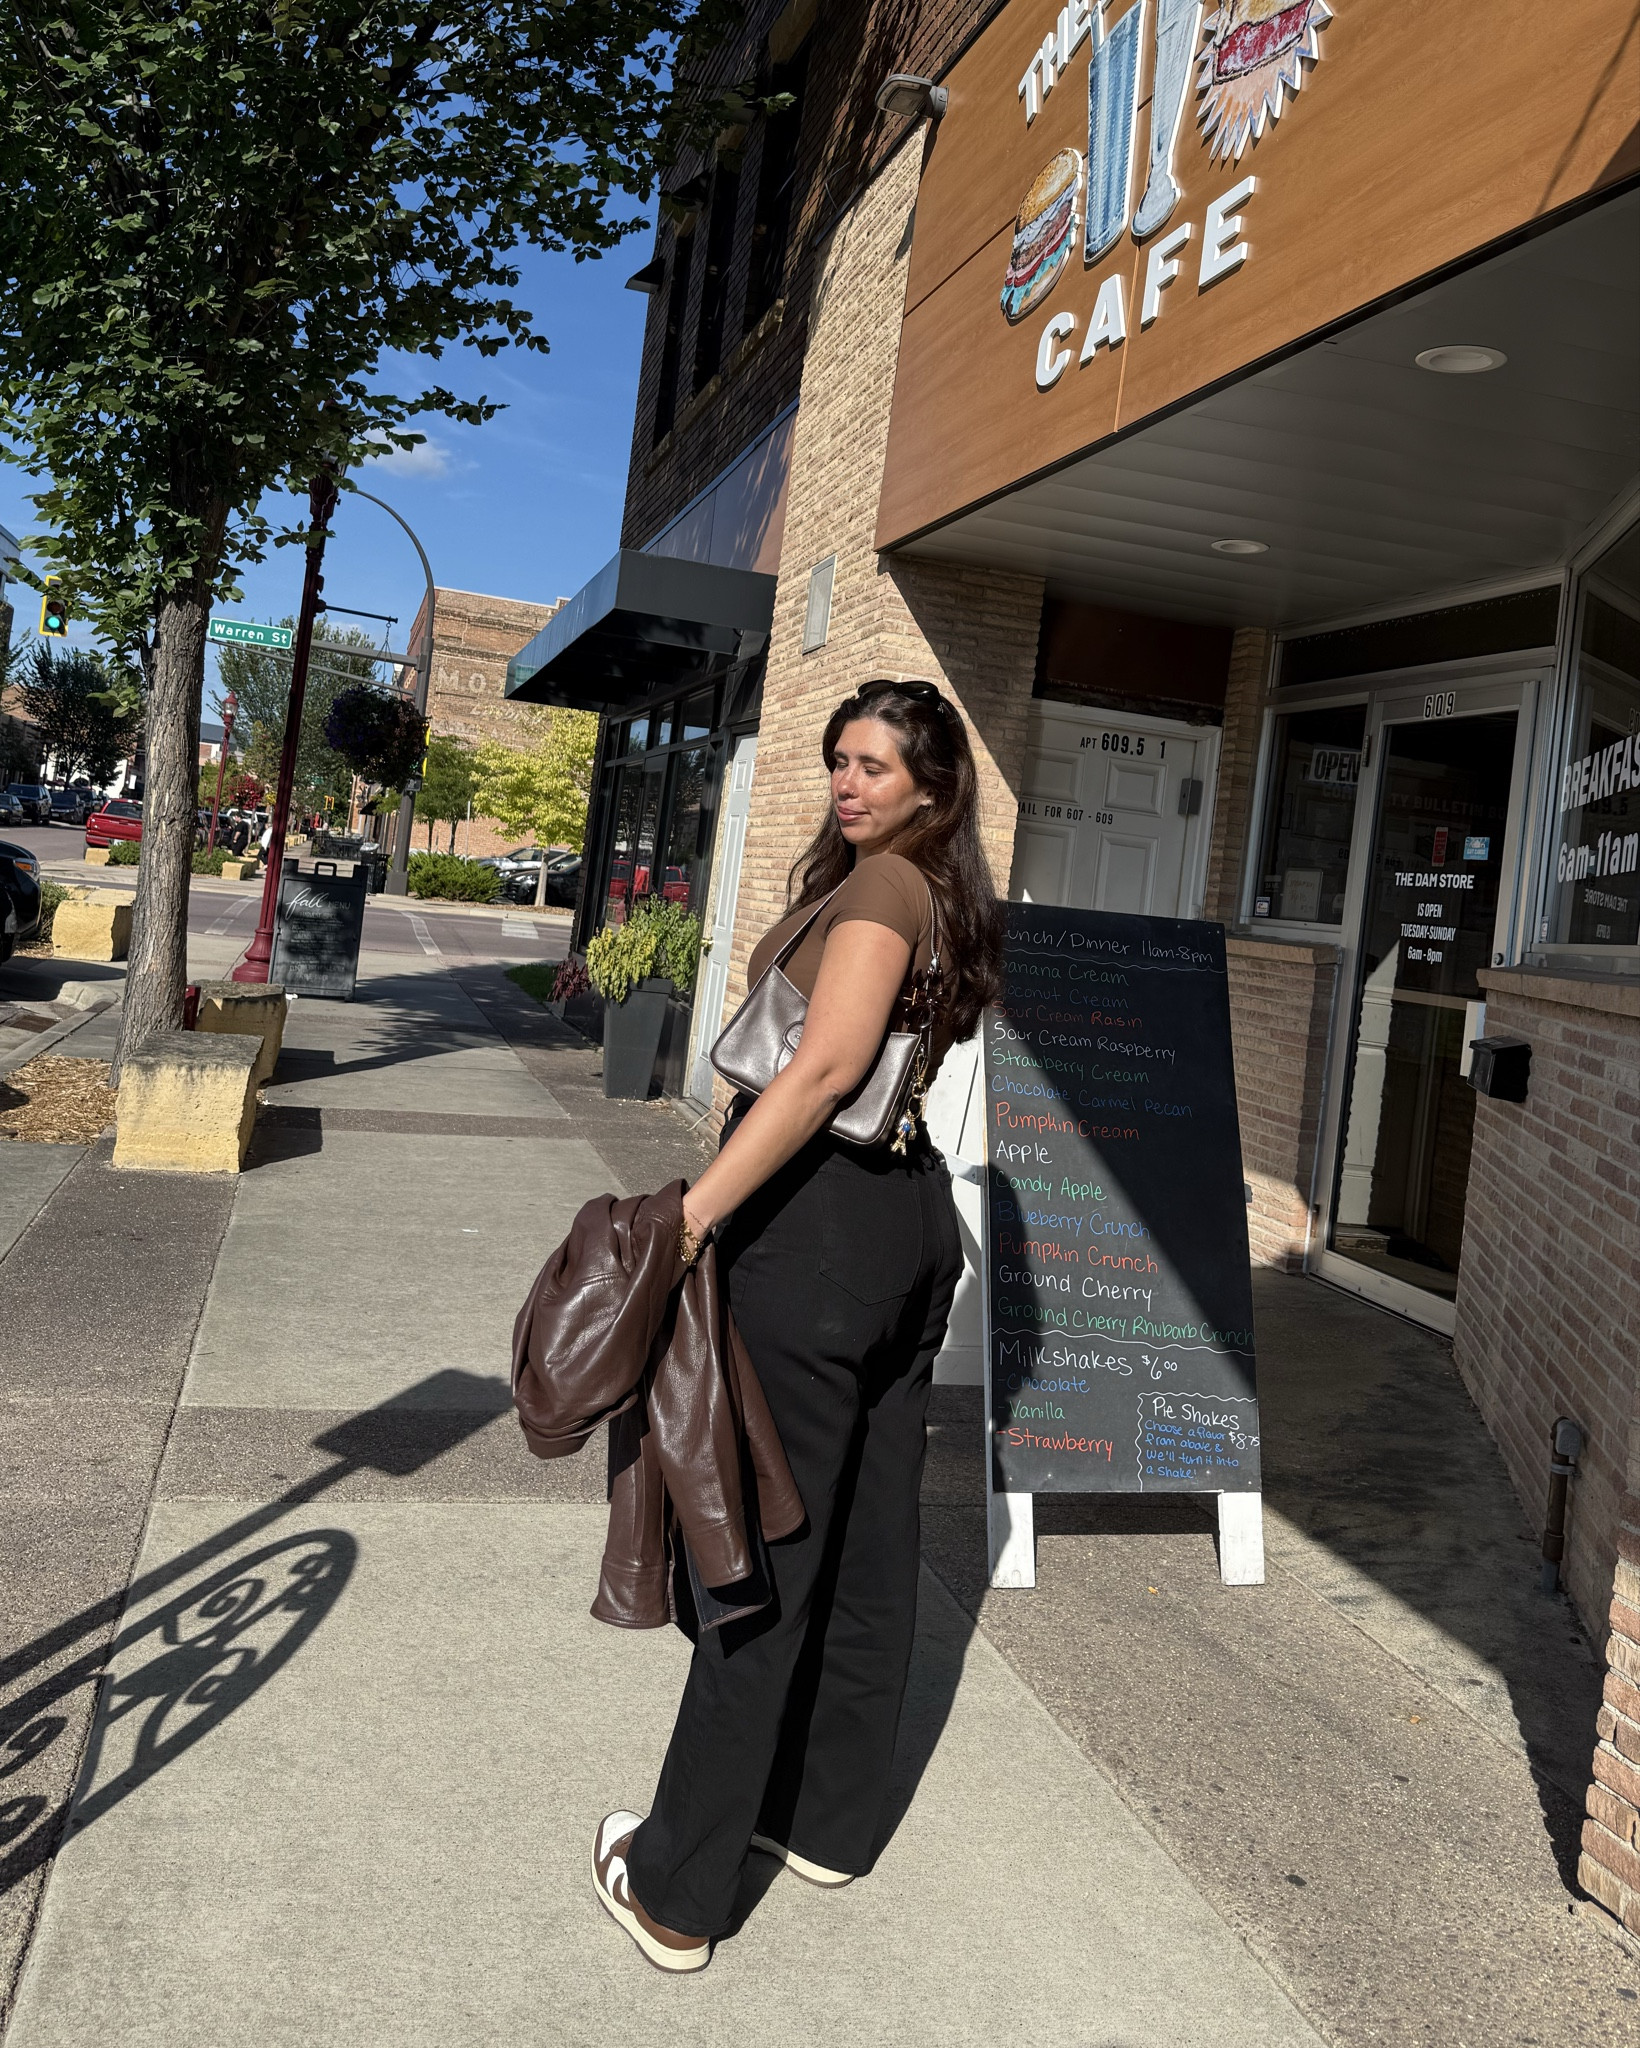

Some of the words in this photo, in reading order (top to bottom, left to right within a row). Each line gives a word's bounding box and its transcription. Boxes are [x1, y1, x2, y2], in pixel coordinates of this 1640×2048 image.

[1018, 0, 1091, 123] THE
[1035, 175, 1256, 388] CAFE
[214, 623, 264, 641] Warren
[271, 632, 287, 644] St
[1424, 692, 1455, 718] 609
[1080, 737, 1097, 749] APT
[1101, 733, 1145, 756] 609.5
[1160, 740, 1166, 759] 1
[1314, 751, 1361, 782] OPEN
[1044, 805, 1062, 818] FOR
[1066, 808, 1084, 821] 607
[1095, 812, 1114, 825] 609
[1395, 872, 1413, 887] THE
[1415, 873, 1438, 888] DAM
[1439, 873, 1475, 890] STORE
[285, 887, 329, 920] fall
[327, 901, 351, 910] MENU
[1417, 902, 1425, 917] IS
[1425, 903, 1443, 918] OPEN
[1001, 930, 1131, 956] unch/Dinner
[1407, 946, 1423, 961] 6am
[1427, 947, 1443, 965] 8pm
[1002, 959, 1062, 979] anana
[1068, 963, 1130, 986] Cream
[1003, 984, 1061, 1001] oconut
[1069, 988, 1129, 1009] Cream
[991, 1000, 1032, 1019] Sour
[1036, 1006, 1084, 1024] Cream
[1090, 1011, 1143, 1029] Raisin
[990, 1022, 1032, 1045] Sour
[1038, 1029, 1092, 1048] Cream
[1097, 1036, 1176, 1065] Raspberry
[992, 1048, 1085, 1081] Strawberry
[1091, 1064, 1150, 1084] Cream
[991, 1074, 1071, 1101] Chocolate
[996, 1101, 1074, 1134] Pumpkin
[1077, 1119, 1141, 1141] Cream
[996, 1139, 1053, 1164] Apple
[995, 1170, 1052, 1200] Candy
[1060, 1176, 1107, 1201] Apple
[996, 1200, 1083, 1237] Blueberry
[1089, 1213, 1151, 1240] Crunch
[998, 1231, 1079, 1264] Pumpkin
[1087, 1246, 1158, 1274] Crunch
[999, 1264, 1071, 1293] Ground
[1081, 1277, 1152, 1312] Cherry
[998, 1297, 1067, 1327] Ground
[1072, 1310, 1126, 1338] Cherry
[1132, 1315, 1197, 1341] Rhubarb
[1199, 1321, 1255, 1347] Crunch
[999, 1340, 1134, 1376] Milkshakes
[1152, 1396, 1177, 1419] Pie
[1181, 1403, 1240, 1430] Shakes
[1144, 1419, 1183, 1436] Choose
[1187, 1429, 1195, 1437] a
[1196, 1426, 1226, 1440] flavor
[1145, 1433, 1176, 1446] from
[1180, 1439, 1212, 1452] above
[1214, 1443, 1224, 1453] &
[1228, 1431, 1260, 1450] $8.75
[1146, 1465, 1154, 1474] a
[1178, 1452, 1203, 1465] turn
[1205, 1455, 1212, 1465] it
[1216, 1455, 1239, 1467] into
